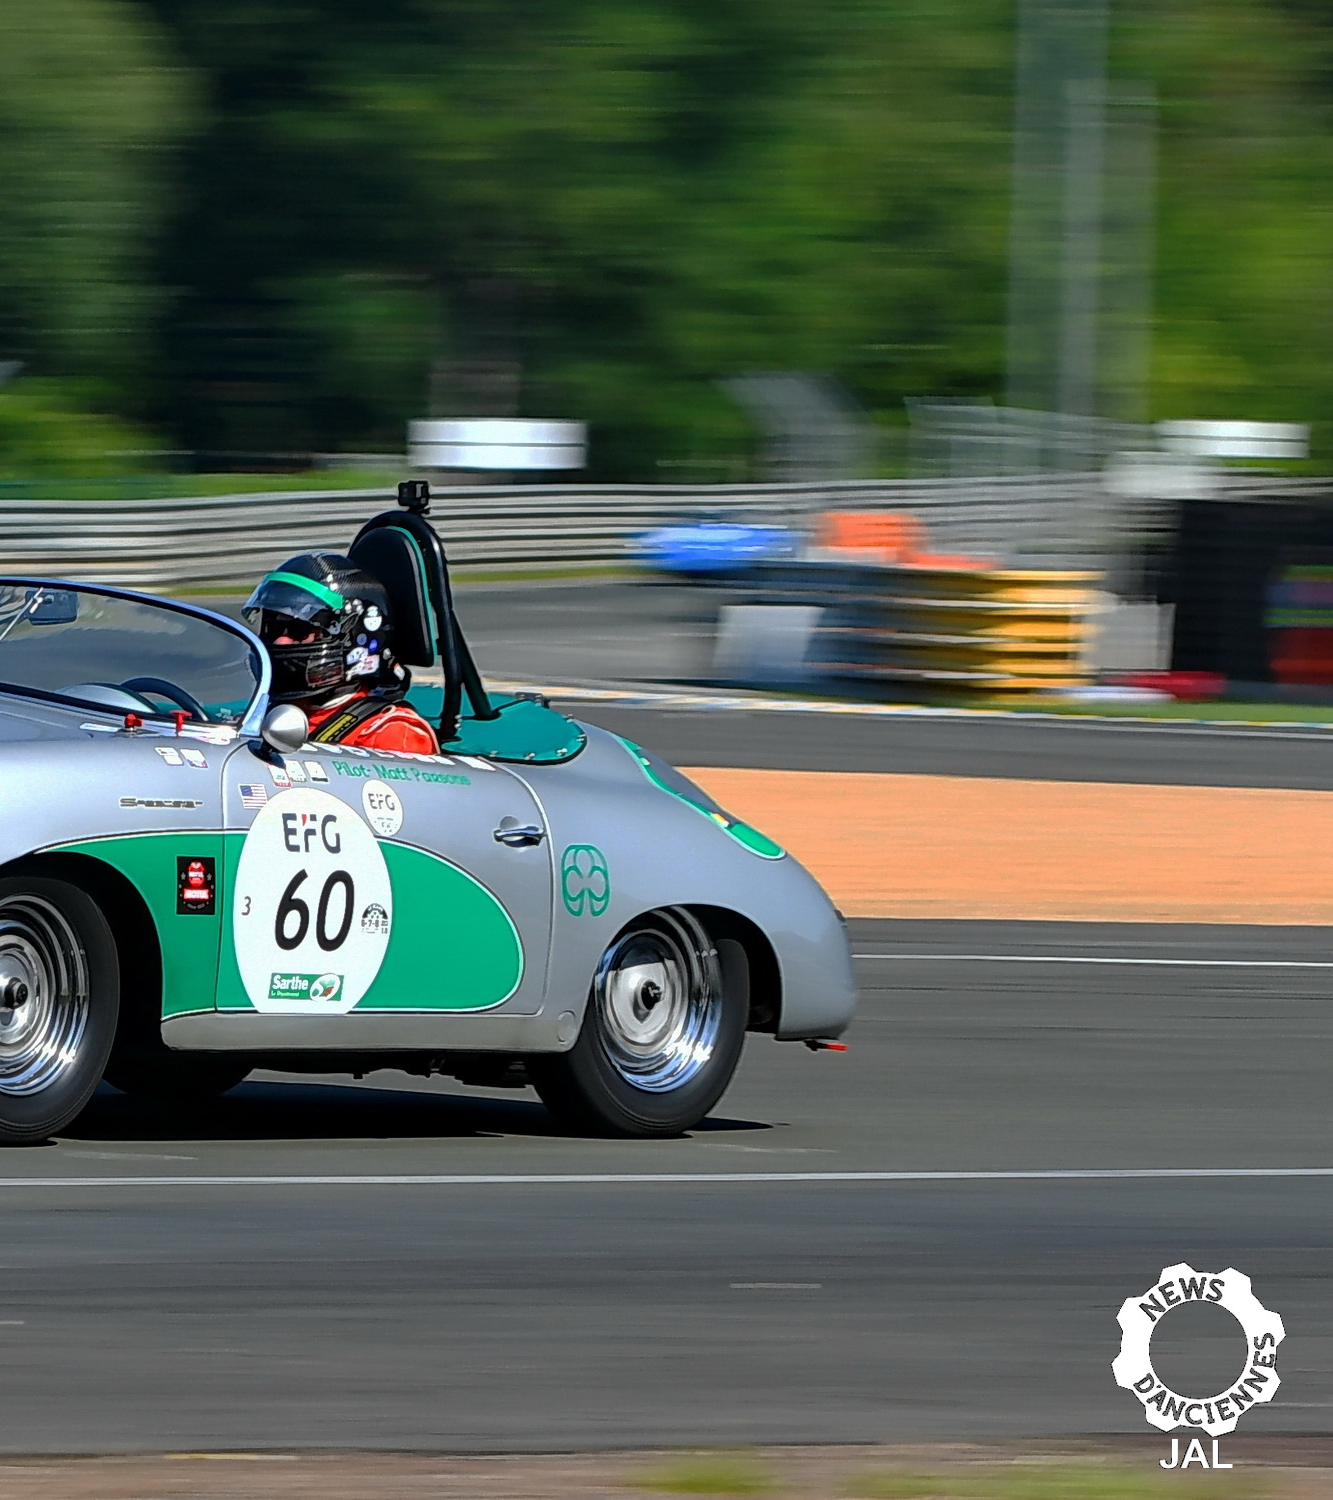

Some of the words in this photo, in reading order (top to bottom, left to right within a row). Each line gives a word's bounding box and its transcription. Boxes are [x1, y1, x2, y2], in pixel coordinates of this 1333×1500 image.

[372, 763, 411, 782] Matt
[367, 793, 395, 811] EFG
[282, 812, 342, 854] EFG
[241, 895, 252, 916] 3
[274, 868, 355, 952] 60
[272, 974, 309, 990] Sarthe
